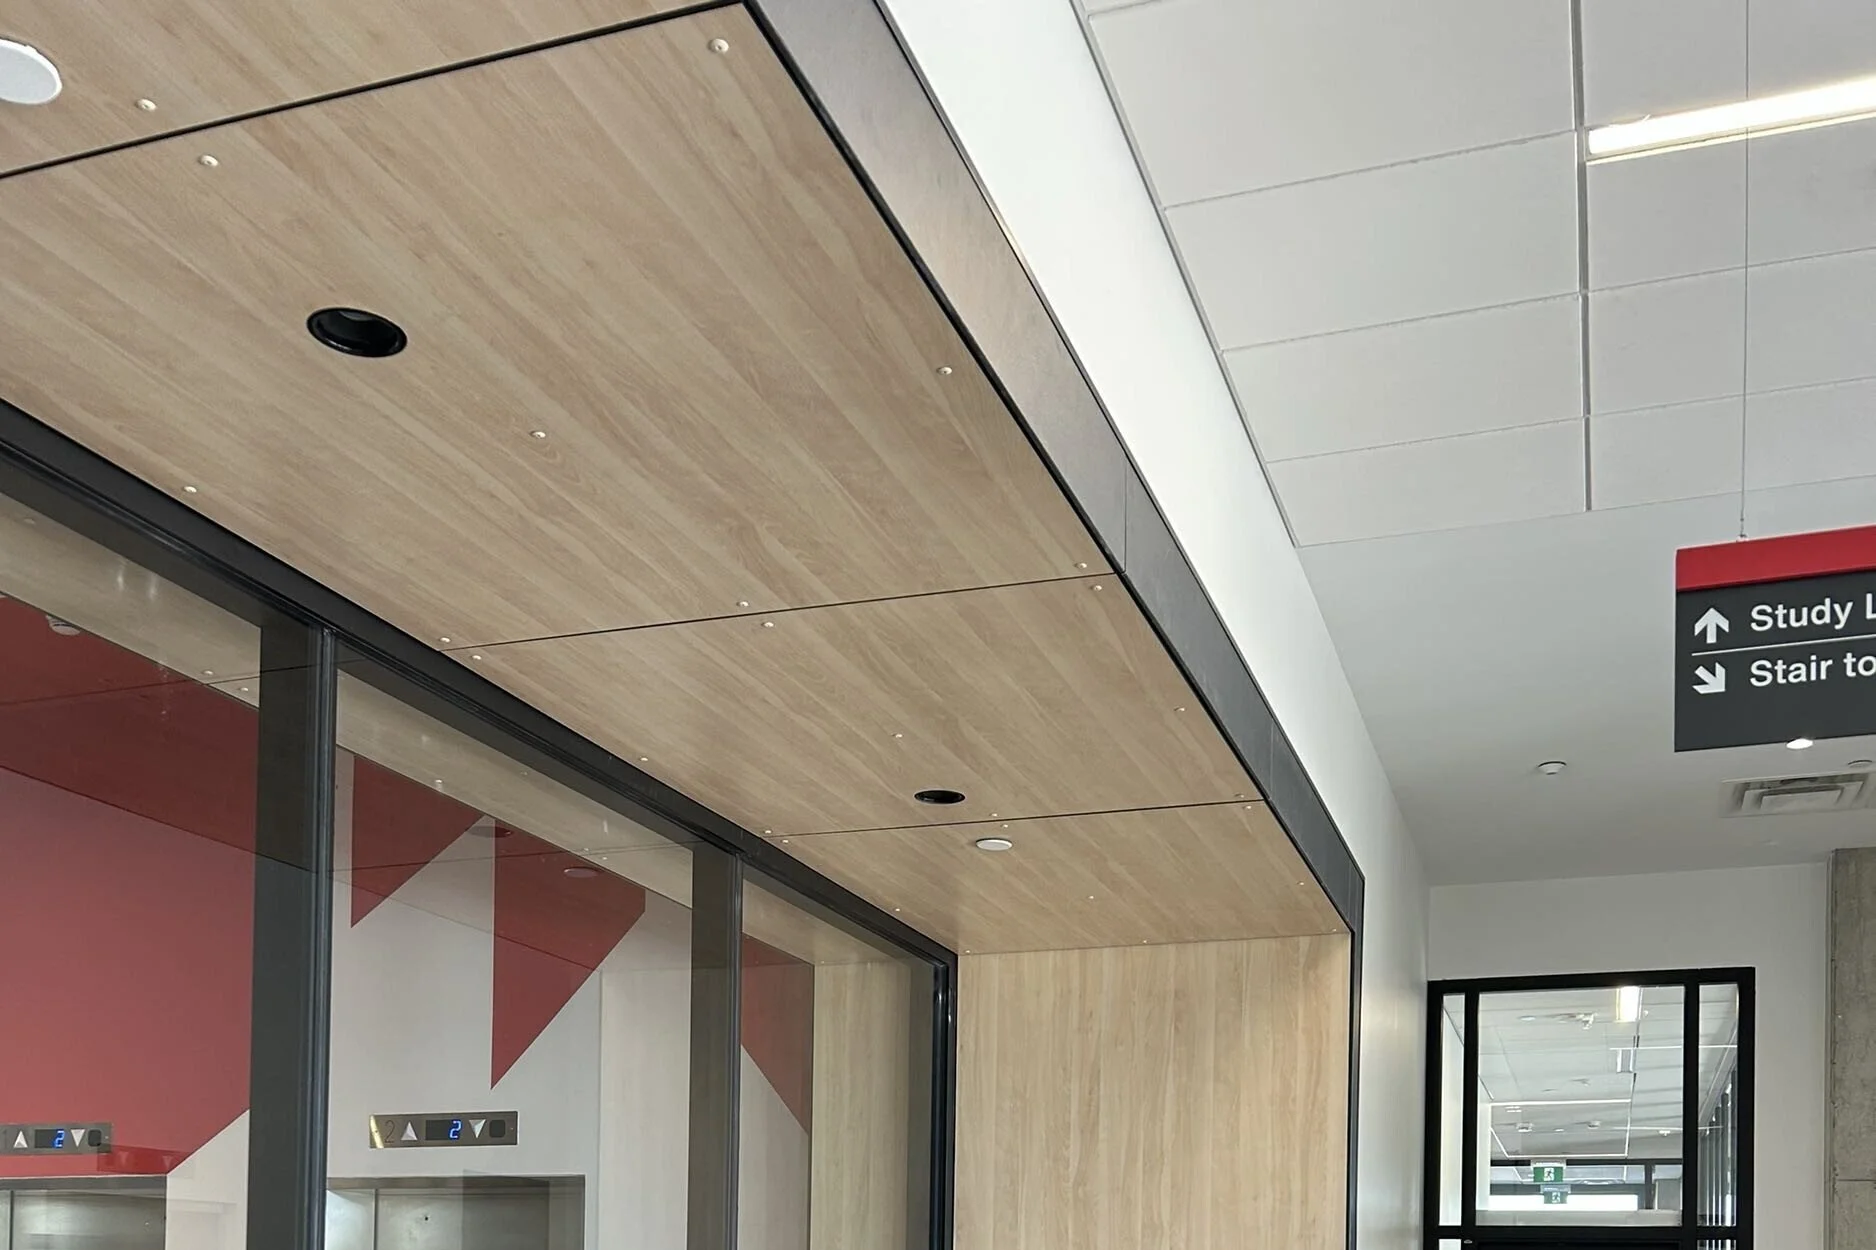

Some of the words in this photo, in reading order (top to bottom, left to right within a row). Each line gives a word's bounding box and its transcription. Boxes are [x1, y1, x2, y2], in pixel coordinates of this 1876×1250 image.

[1750, 598, 1854, 632] Study
[1749, 654, 1833, 687] Stair
[54, 1130, 65, 1148] 2
[384, 1119, 396, 1144] 2
[449, 1120, 462, 1139] 2
